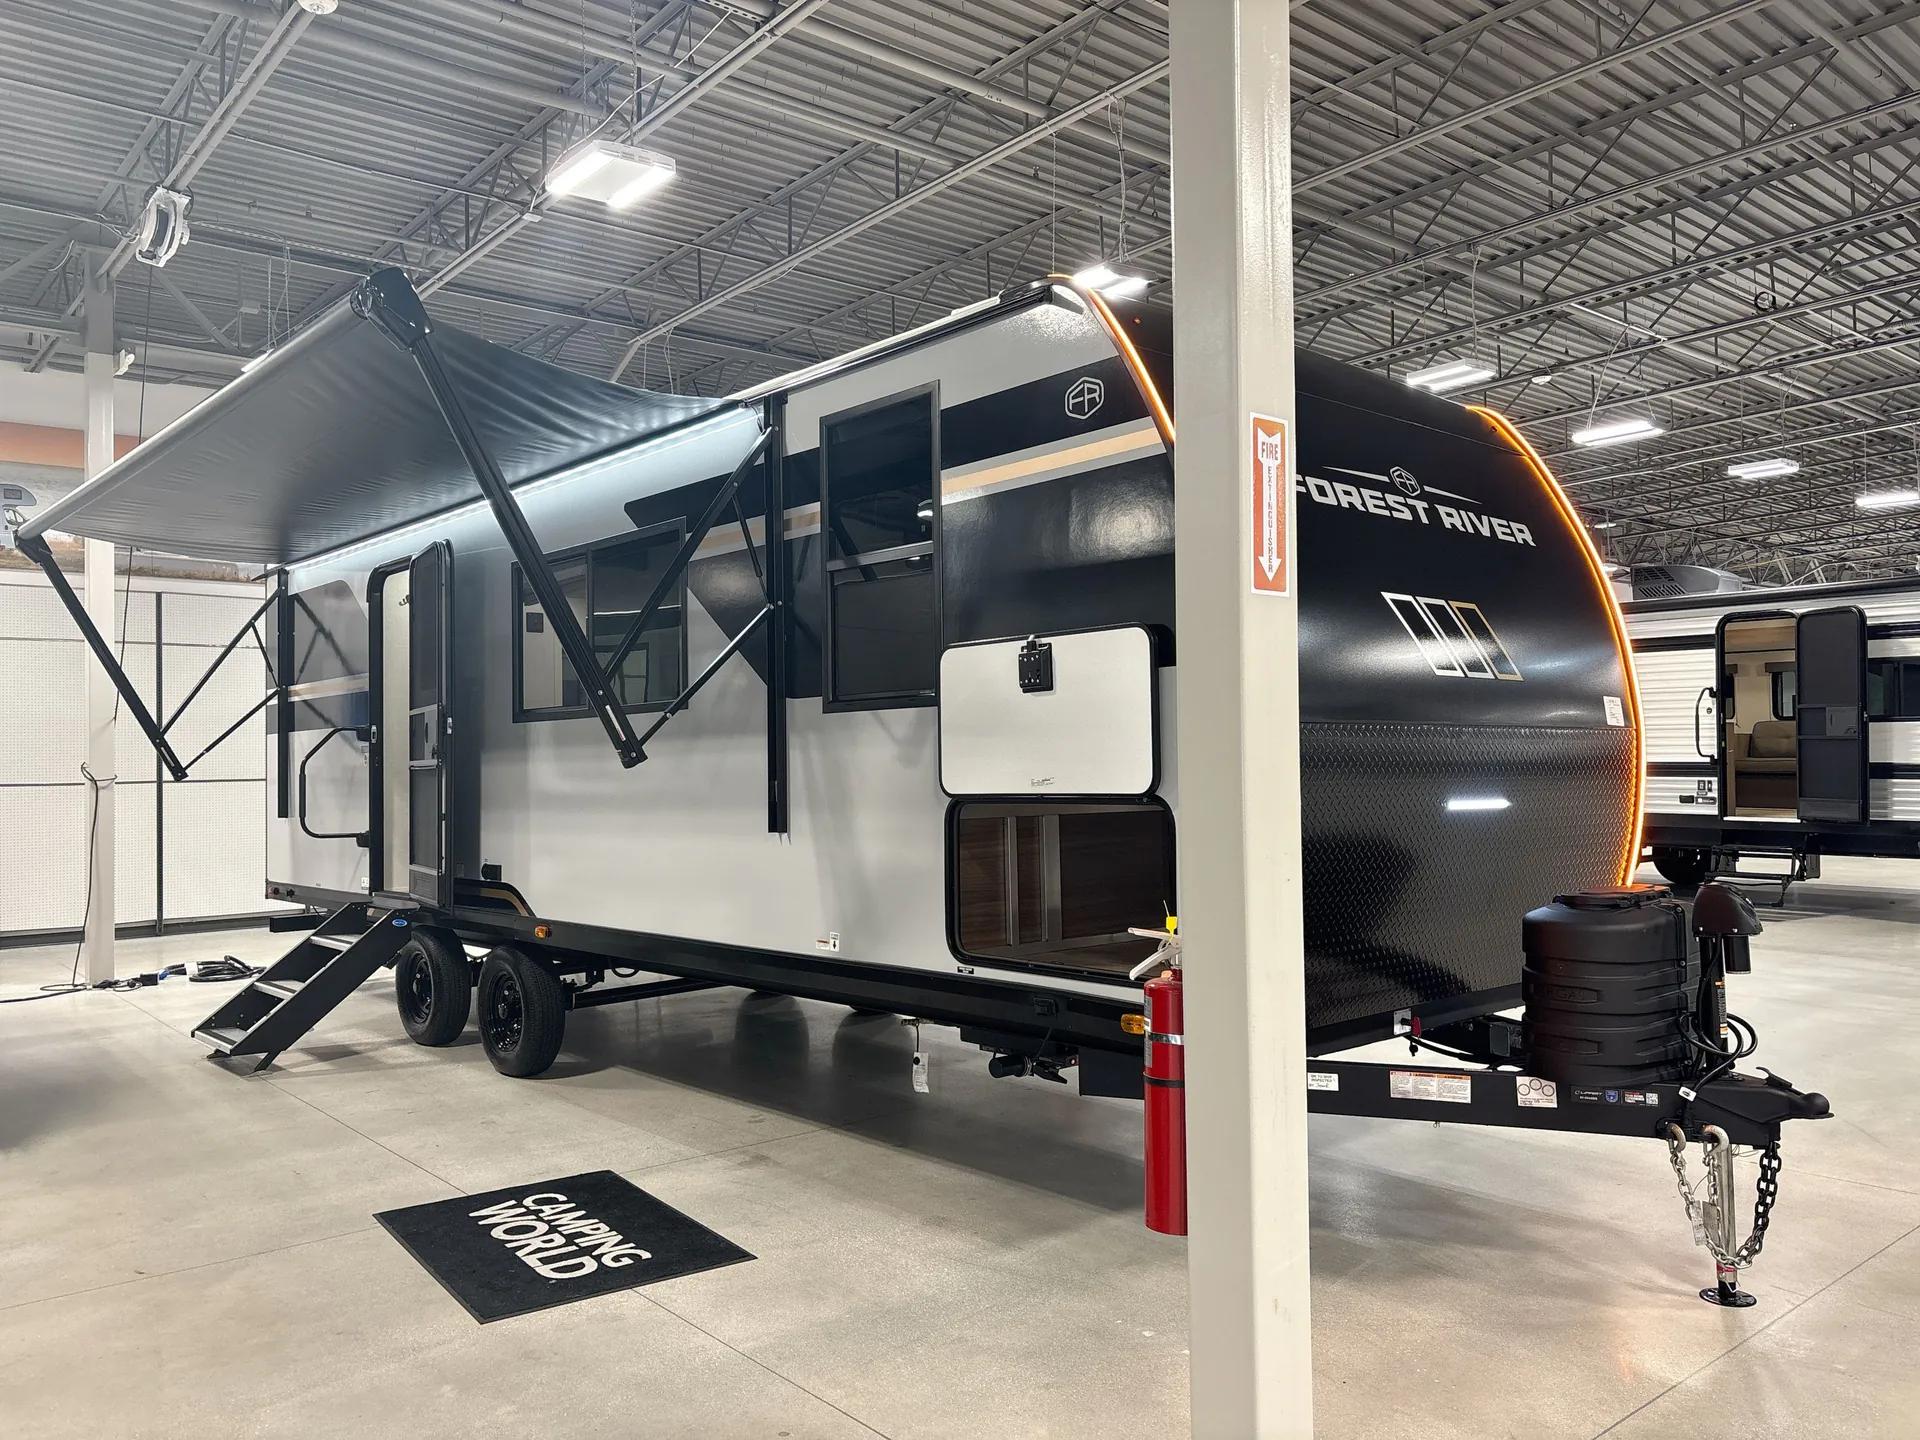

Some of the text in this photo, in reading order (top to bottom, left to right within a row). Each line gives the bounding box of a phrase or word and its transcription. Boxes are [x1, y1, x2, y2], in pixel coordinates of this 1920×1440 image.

[1260, 441, 1279, 461] FIRE
[1434, 503, 1537, 547] RIVER
[468, 1199, 599, 1279] WORLD
[522, 1192, 652, 1268] CAMPING
